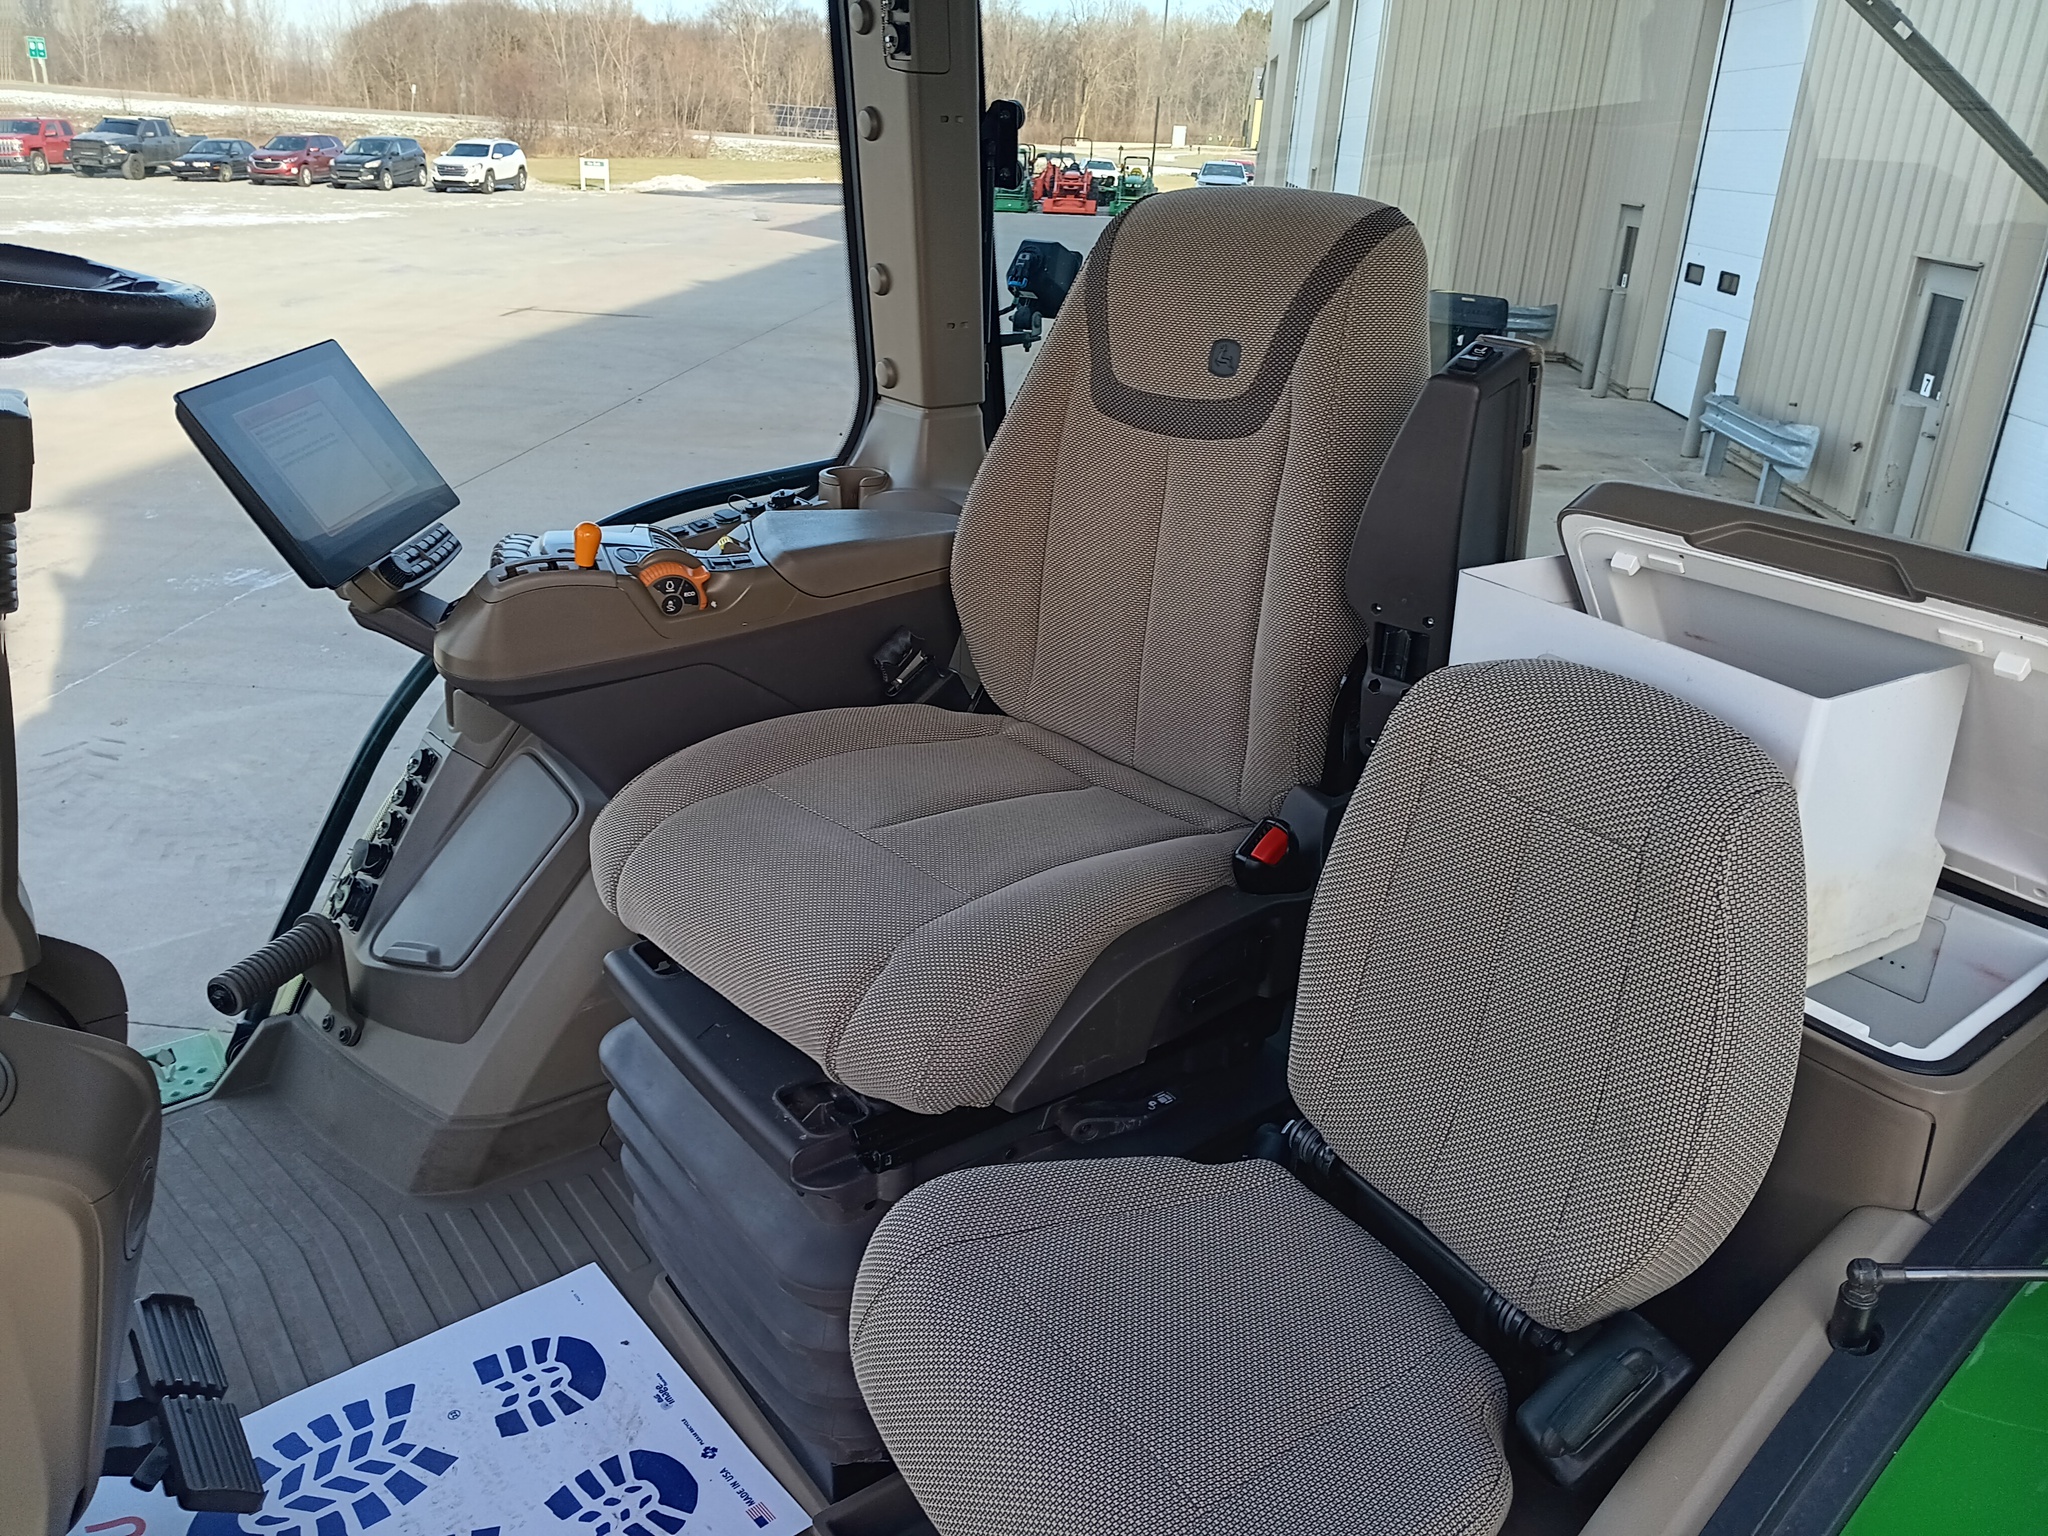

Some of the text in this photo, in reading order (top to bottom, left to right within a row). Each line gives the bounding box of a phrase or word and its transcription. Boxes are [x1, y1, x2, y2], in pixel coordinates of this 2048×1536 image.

[1924, 378, 1931, 392] 7
[656, 1383, 675, 1404] image
[719, 1467, 756, 1507] MADE IN USA
